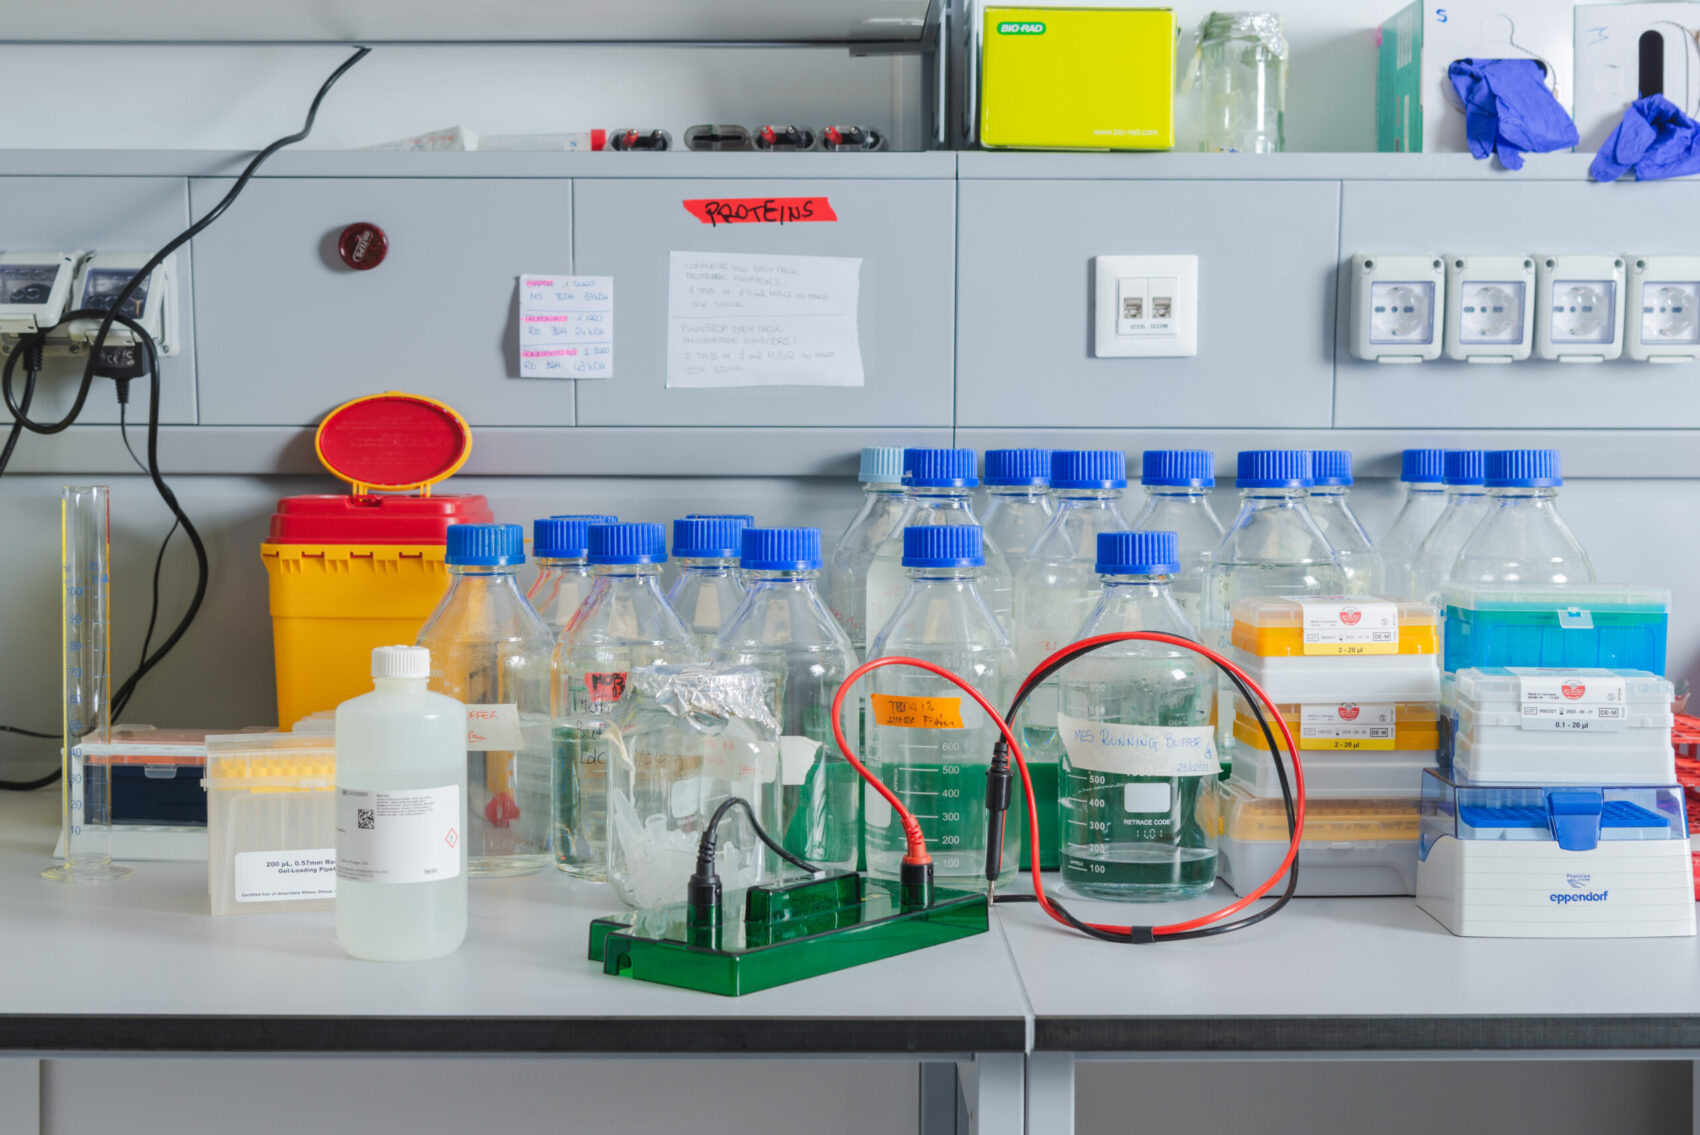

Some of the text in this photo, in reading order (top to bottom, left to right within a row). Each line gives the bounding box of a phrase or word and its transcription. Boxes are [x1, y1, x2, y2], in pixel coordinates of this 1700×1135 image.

[1436, 9, 1448, 23] S
[1000, 24, 1043, 33] BIO-RAD
[705, 200, 813, 227] PROTEINS
[1100, 728, 1158, 752] RUNNING
[942, 743, 959, 751] 600
[942, 766, 959, 775] 500
[1089, 775, 1105, 784] 500
[942, 789, 959, 798] 400
[1089, 798, 1105, 808] 400
[942, 812, 959, 821] 300
[1089, 821, 1105, 830] 300
[71, 826, 82, 836] 10
[942, 836, 959, 845] 200
[943, 859, 959, 868] 100
[1089, 864, 1106, 873] 100
[1549, 890, 1608, 904] eppendorf
